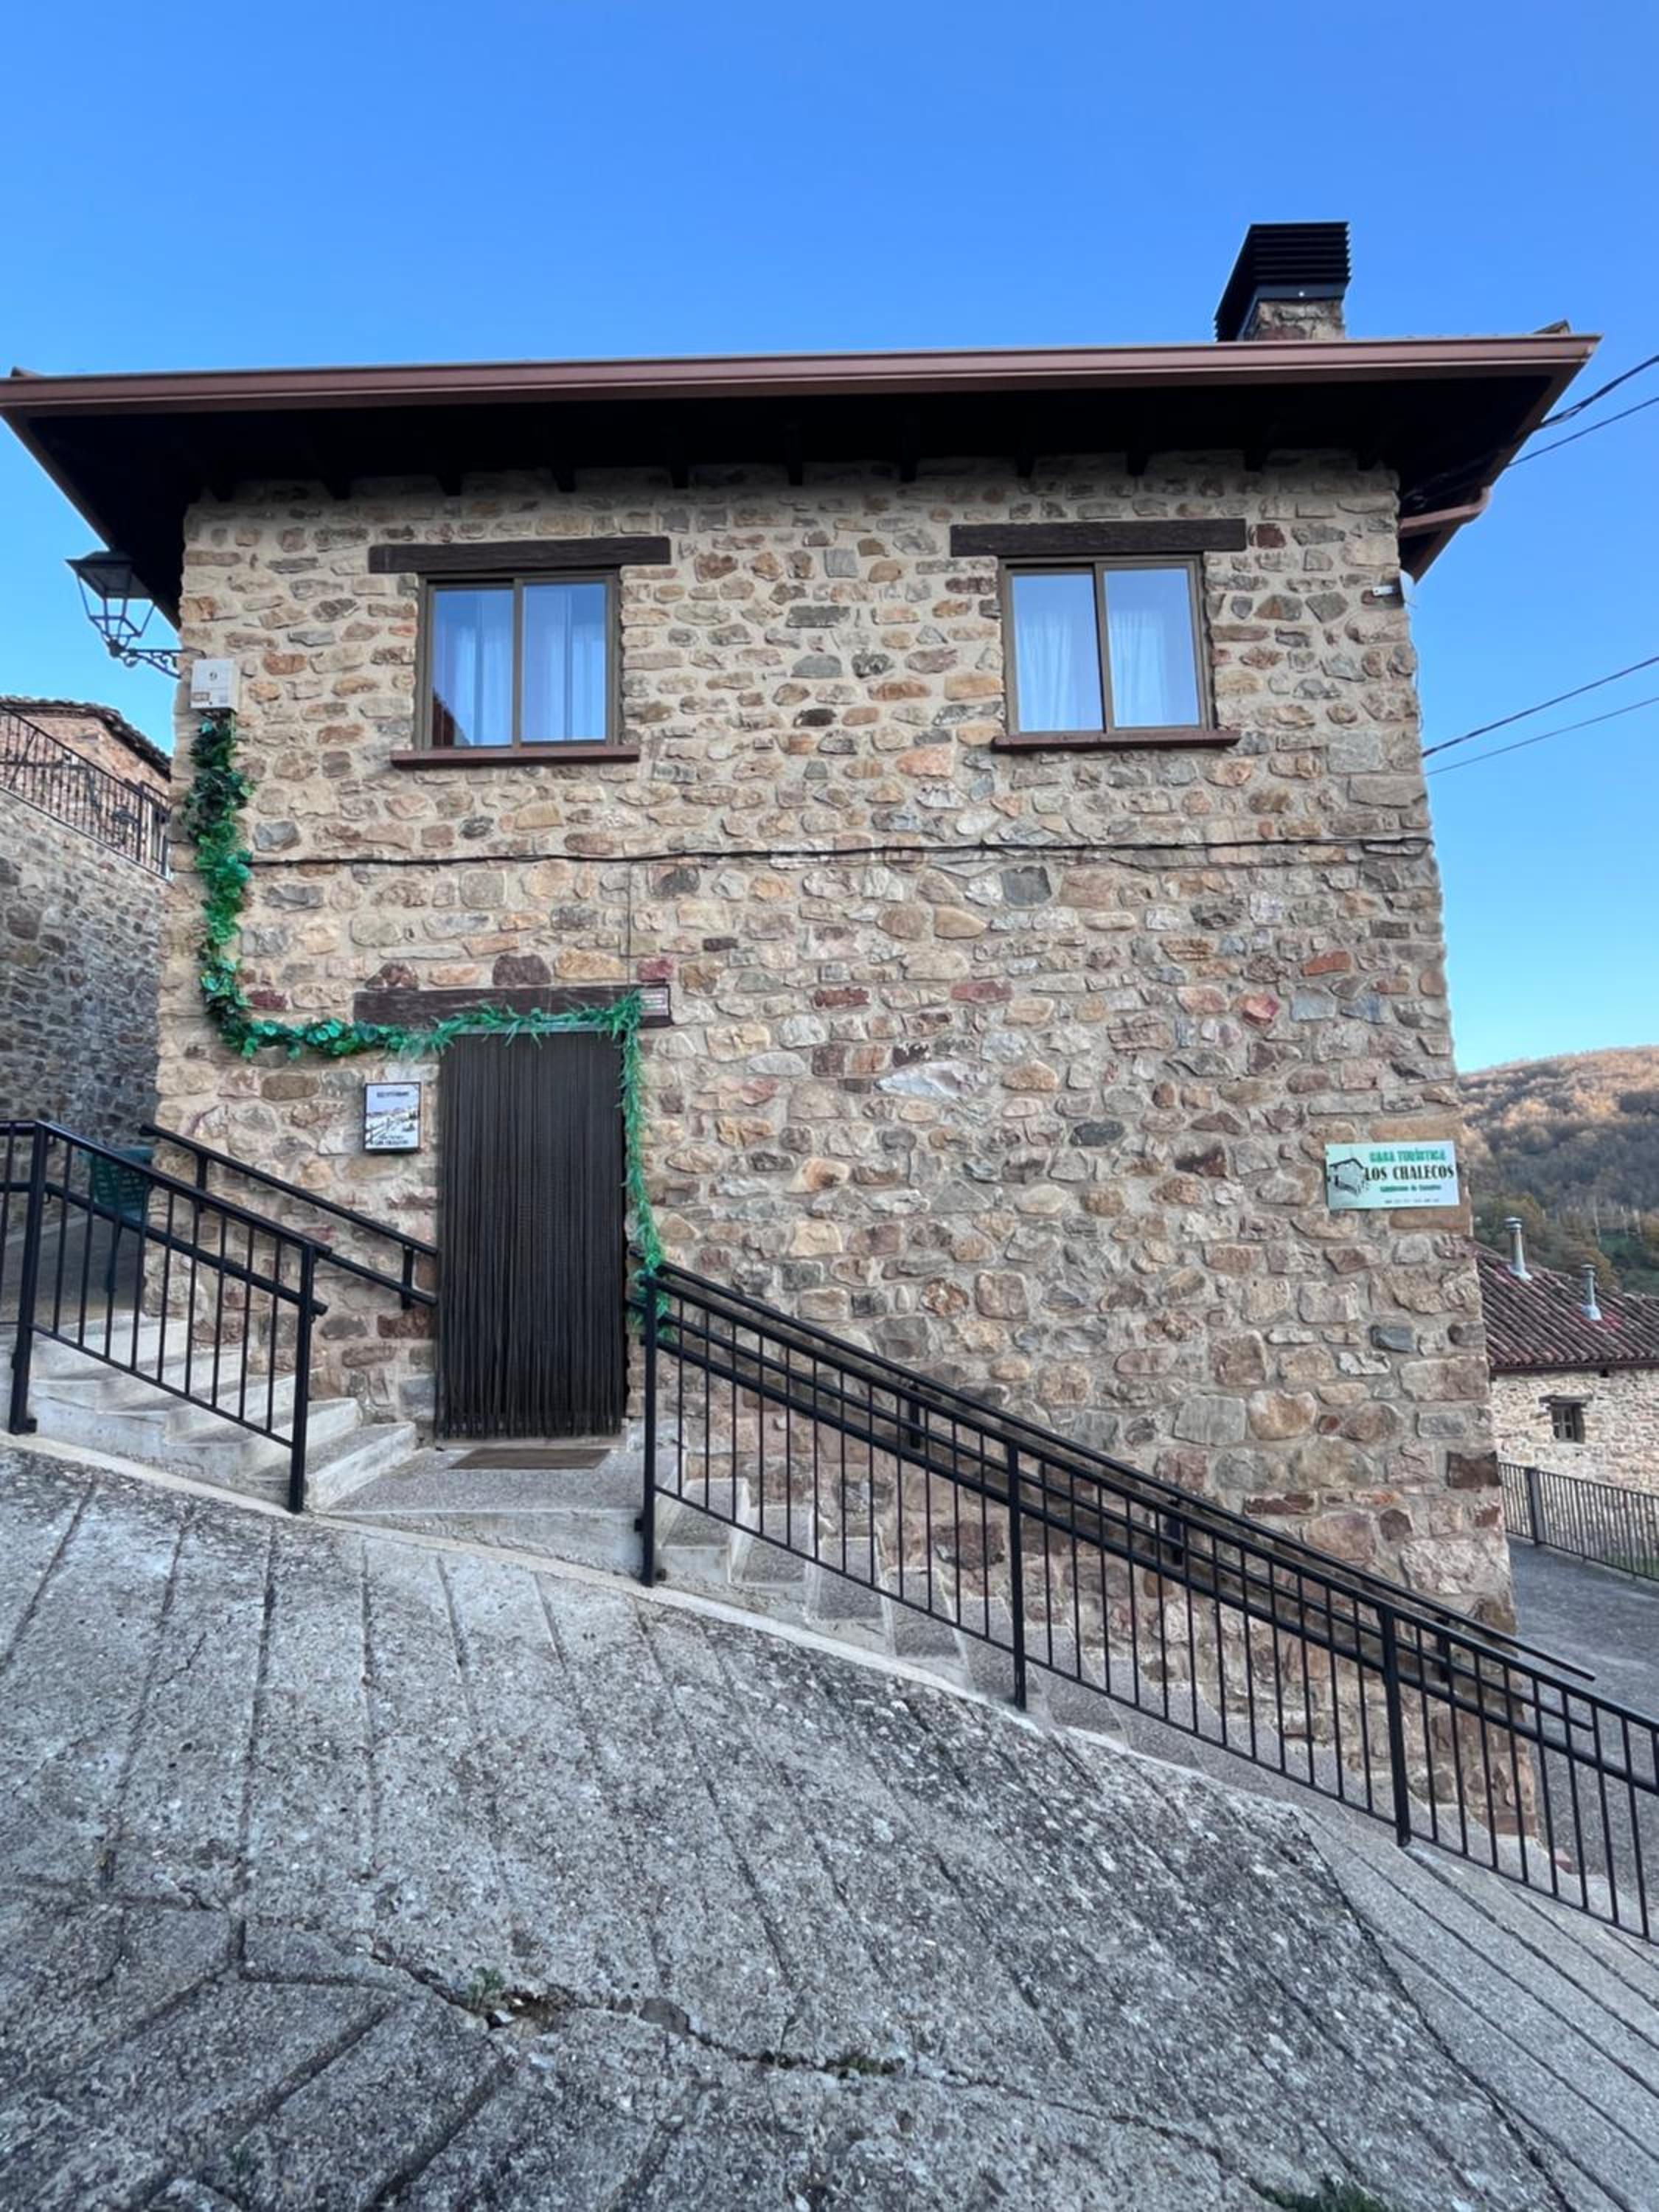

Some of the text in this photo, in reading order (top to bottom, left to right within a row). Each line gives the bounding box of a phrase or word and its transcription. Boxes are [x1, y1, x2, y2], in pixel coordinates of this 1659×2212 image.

[1369, 1152, 1394, 1162] CASA
[1365, 1164, 1454, 1180] LOS CHALECOS
